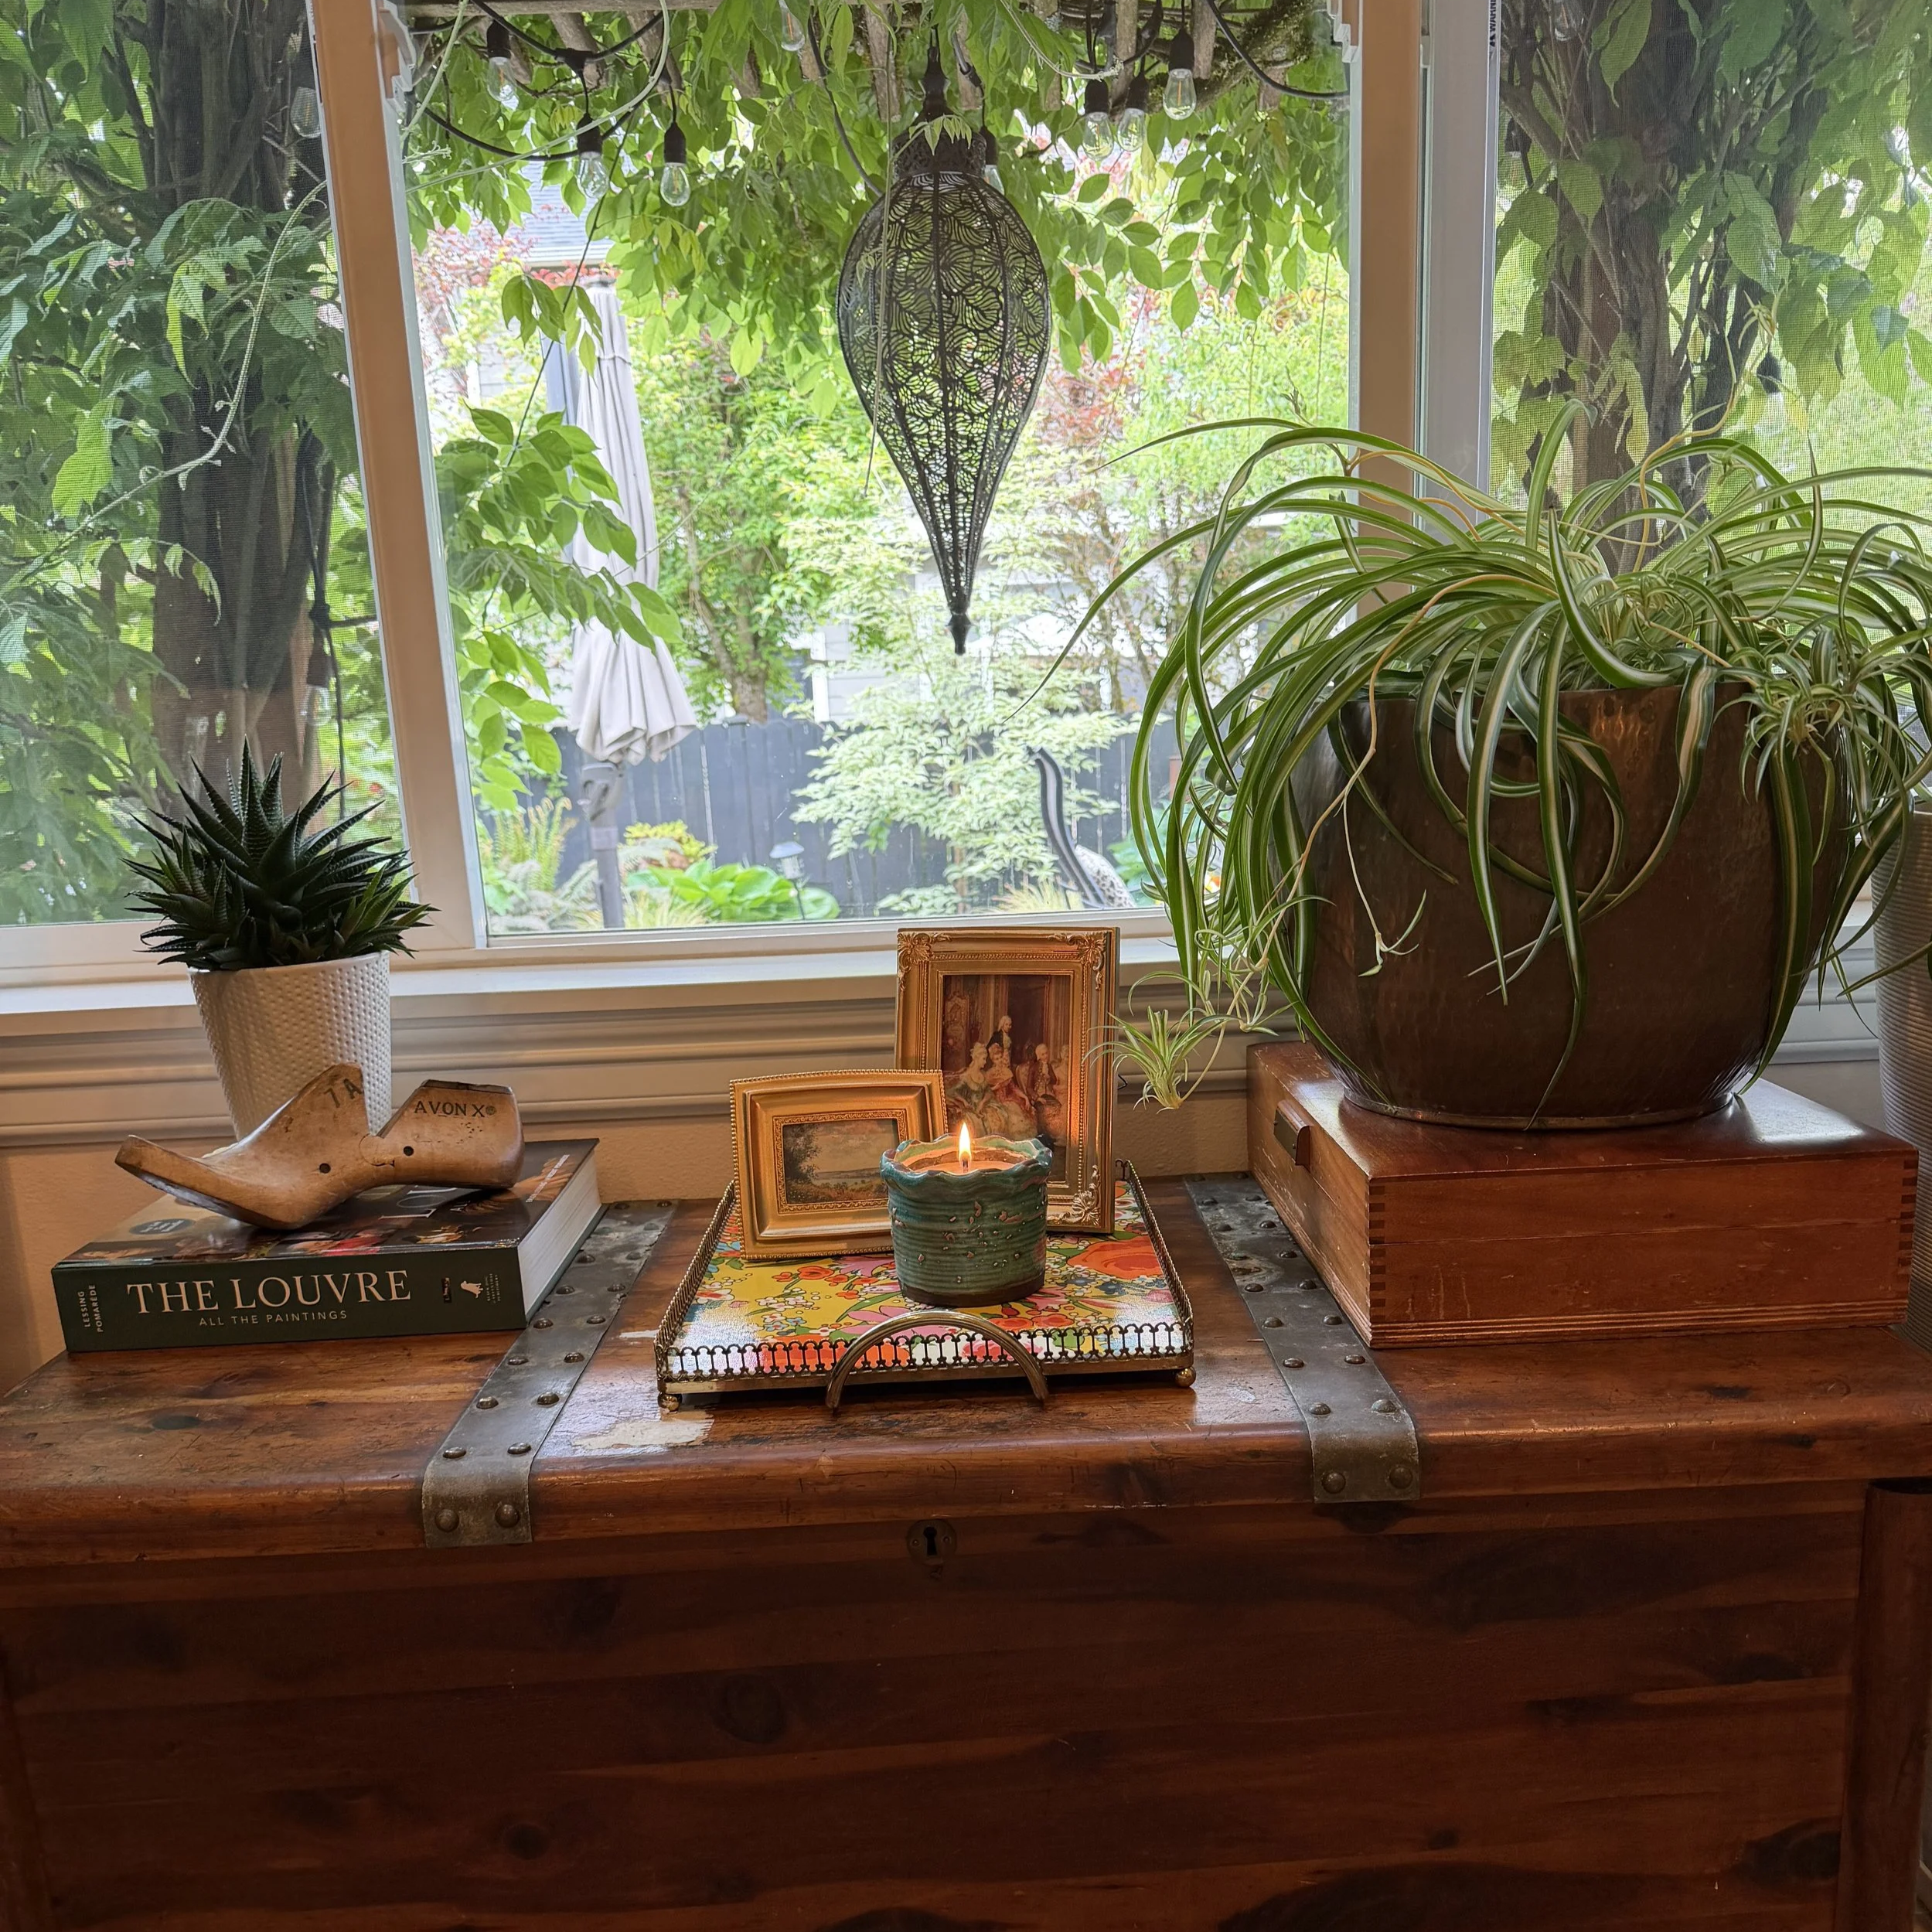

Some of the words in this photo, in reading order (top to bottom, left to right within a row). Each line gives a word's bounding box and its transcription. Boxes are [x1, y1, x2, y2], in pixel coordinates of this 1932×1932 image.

[414, 1100, 467, 1116] AVON
[127, 1279, 219, 1314] THE
[230, 1269, 411, 1310] LOUVRE
[77, 1290, 91, 1327] LESSING
[199, 1317, 224, 1326] ALL
[231, 1315, 259, 1324] THE
[266, 1310, 347, 1323] PAINTINGS
